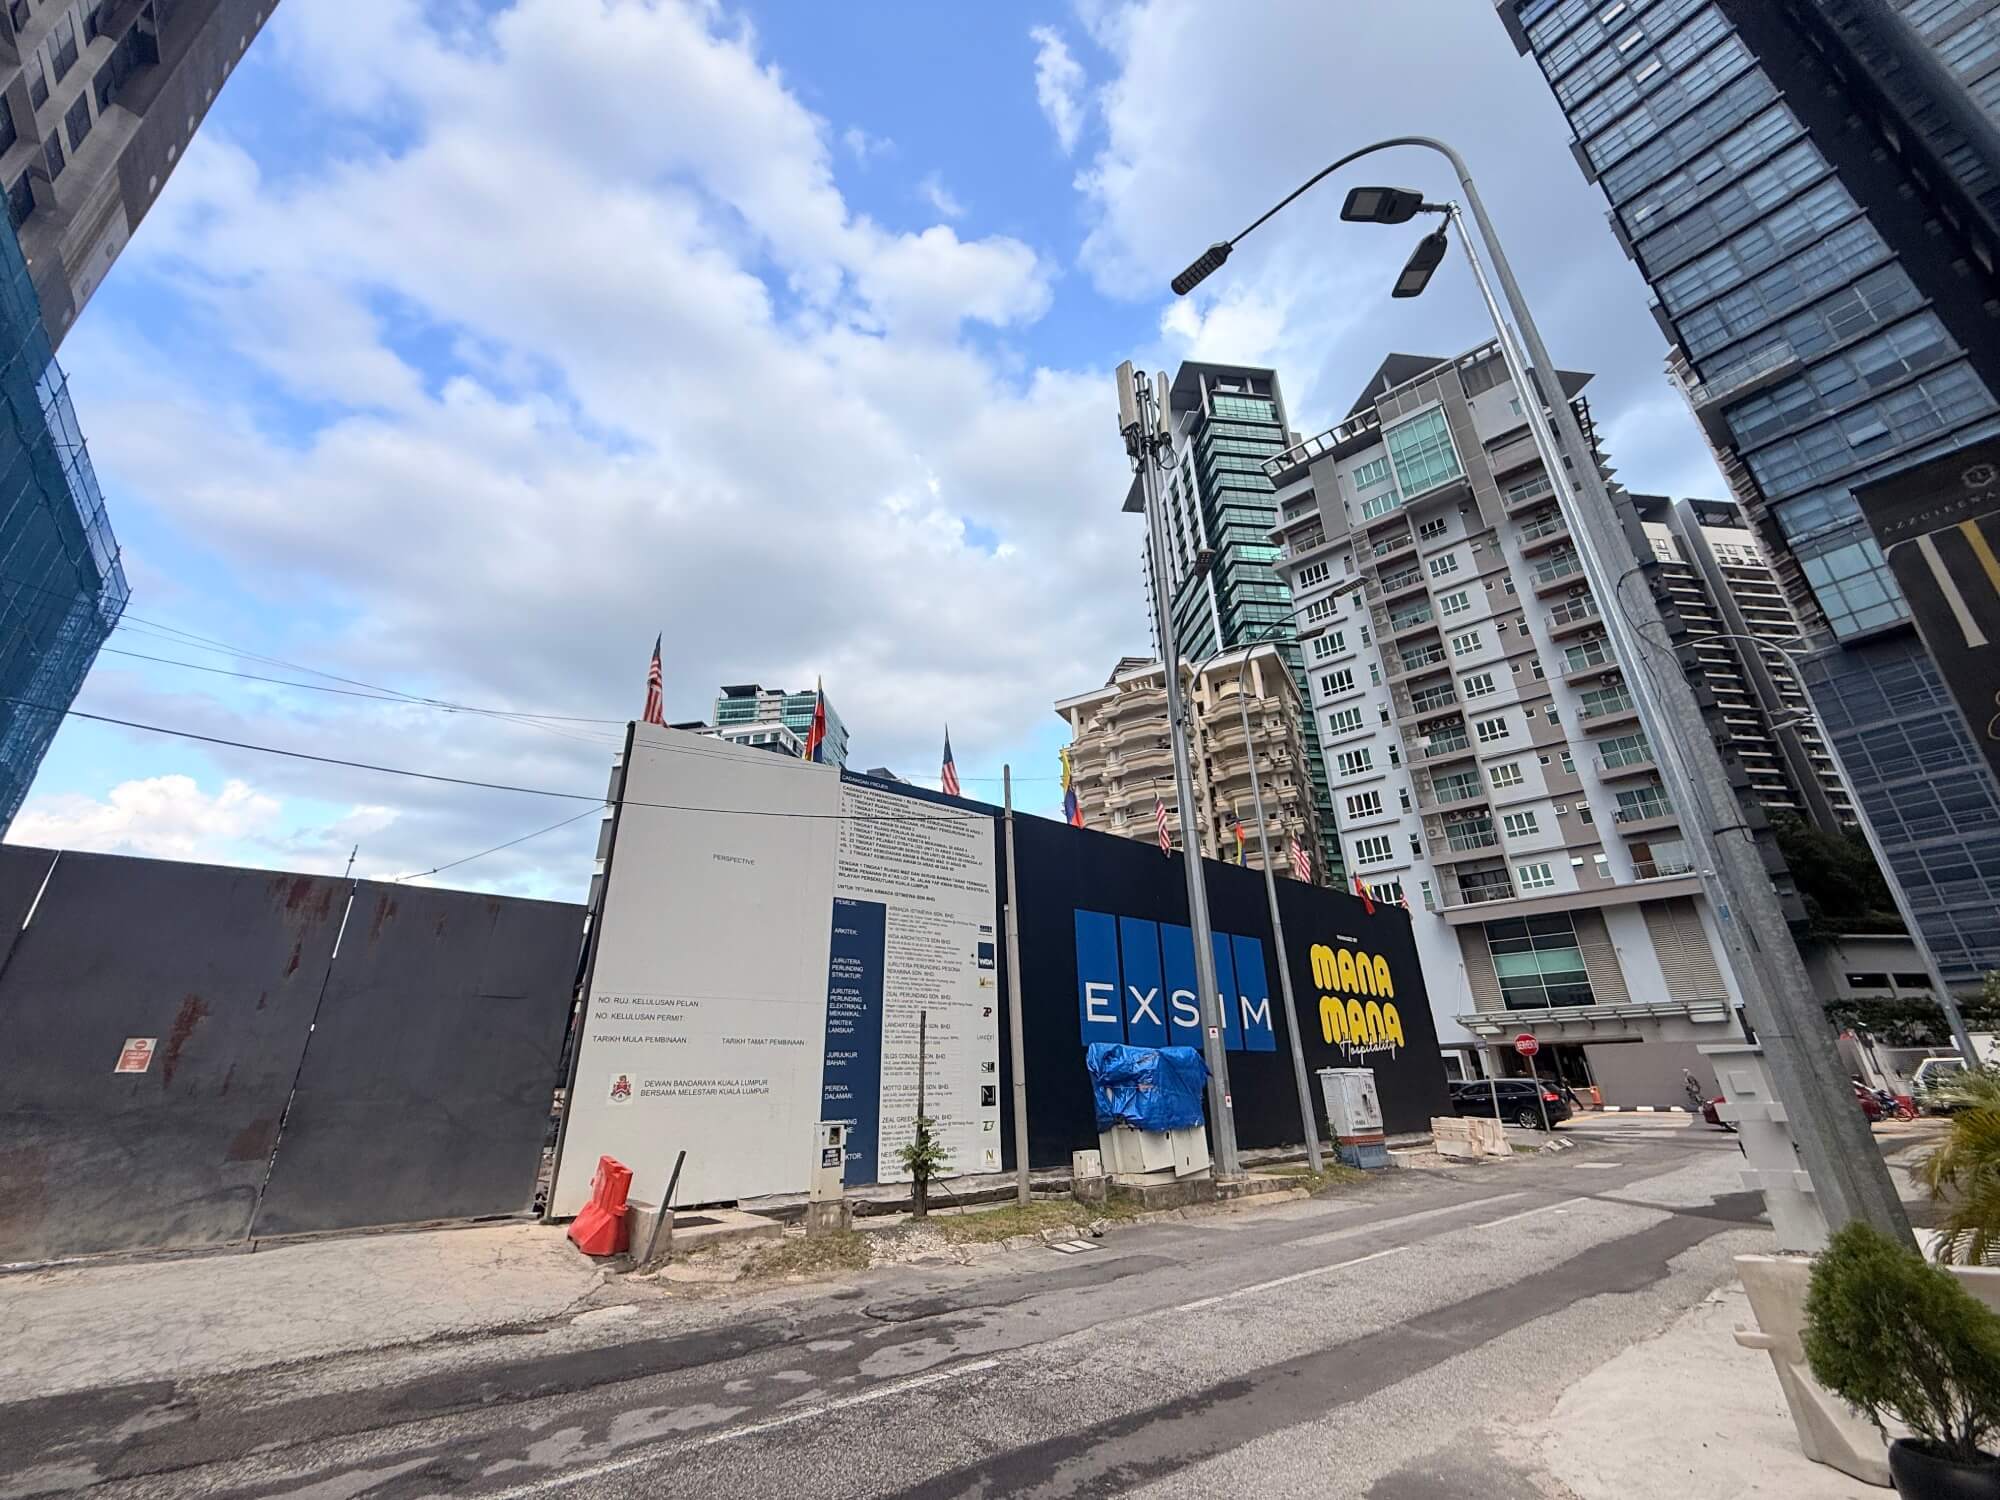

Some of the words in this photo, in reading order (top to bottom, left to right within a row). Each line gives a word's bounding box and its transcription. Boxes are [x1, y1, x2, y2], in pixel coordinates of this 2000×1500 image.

[713, 854, 755, 865] PERSPECTIVE
[1310, 943, 1394, 998] MANA
[632, 998, 675, 1006] KELULUSAN
[1084, 981, 1272, 1031] EXSIM
[611, 1013, 655, 1021] KELULUSAN
[1319, 995, 1405, 1048] MANA
[592, 1035, 620, 1043] TARIKH
[622, 1035, 643, 1043] MULA
[645, 1036, 687, 1044] PEMBINAAN
[722, 1037, 746, 1045] TARIKH
[769, 1038, 804, 1046] PEMBINAAN
[673, 1079, 716, 1087] BANDARAYA
[717, 1079, 739, 1087] KUALA
[640, 1089, 676, 1097] BERSAMA
[678, 1088, 717, 1096] MELESTARI
[742, 1087, 769, 1095] LUMPUR
